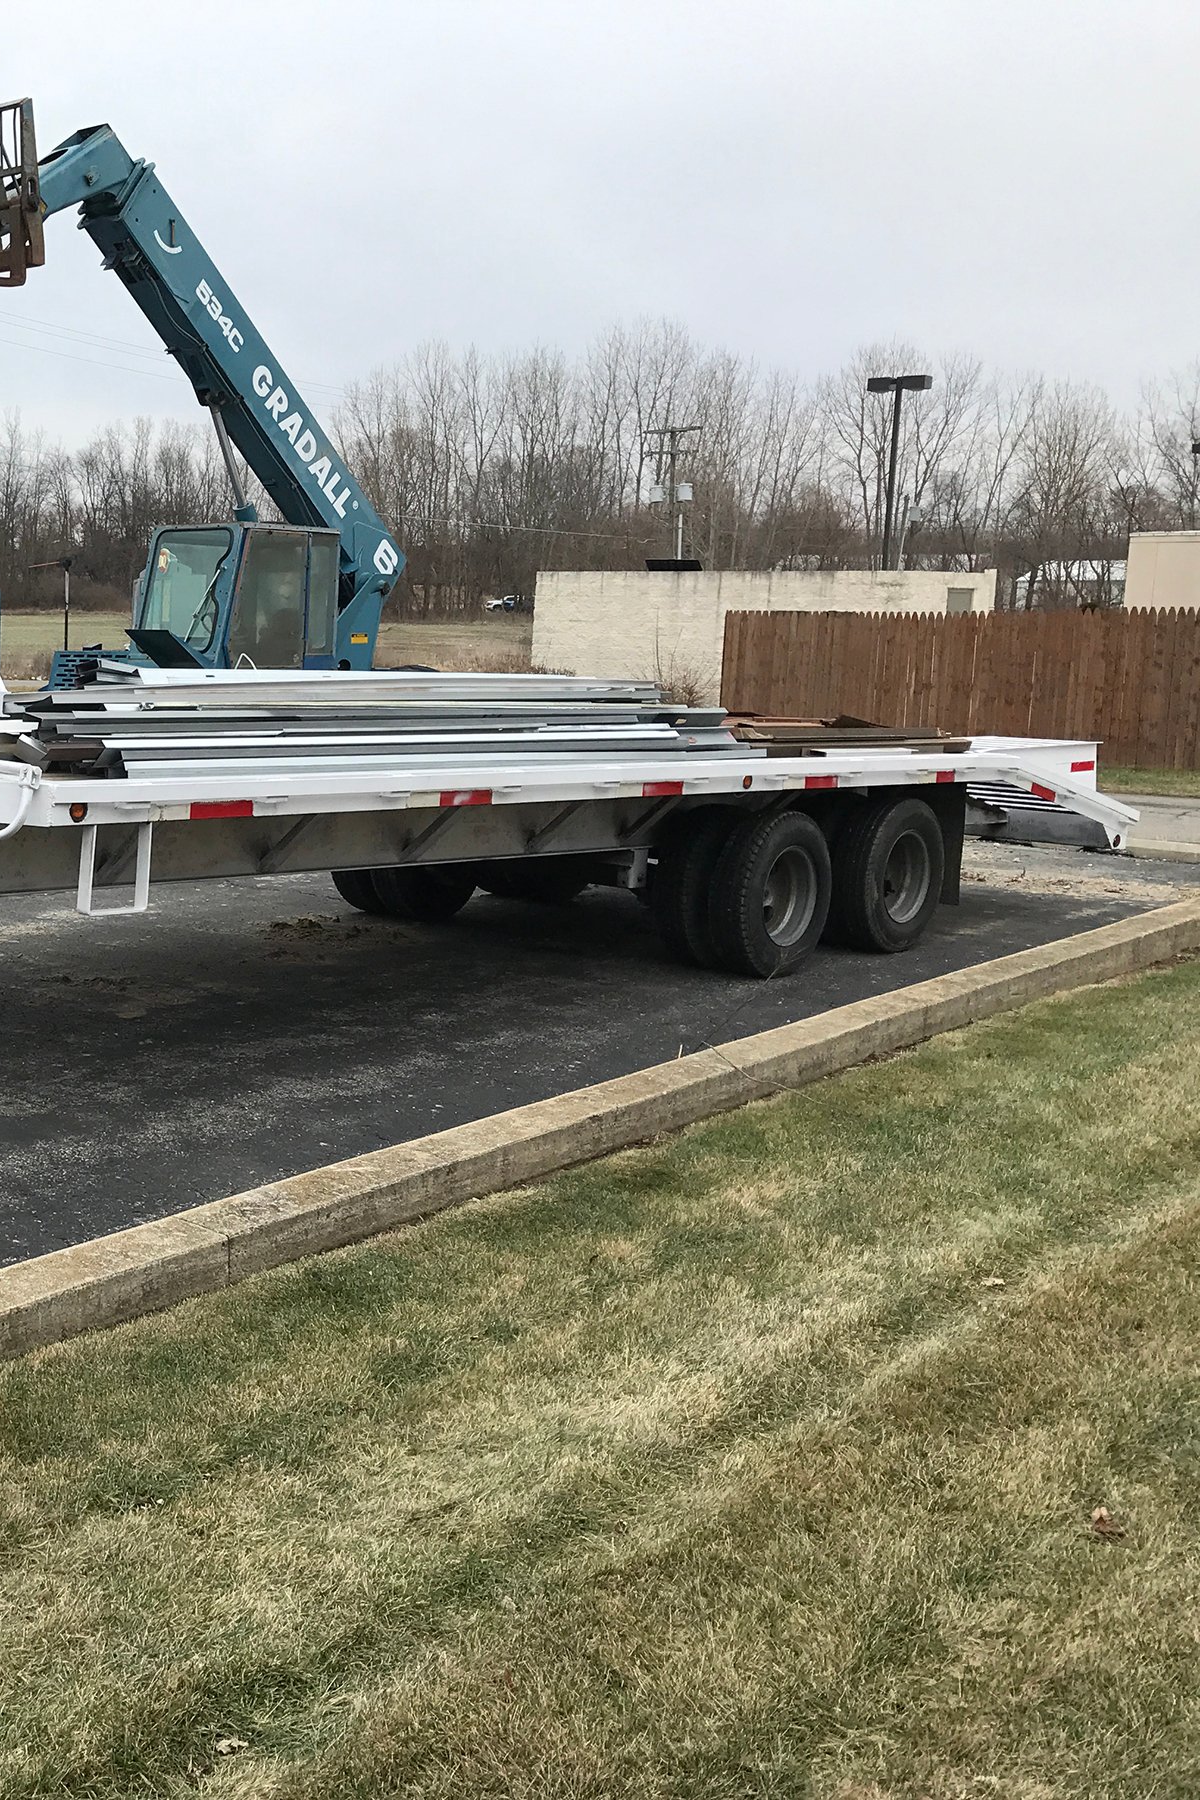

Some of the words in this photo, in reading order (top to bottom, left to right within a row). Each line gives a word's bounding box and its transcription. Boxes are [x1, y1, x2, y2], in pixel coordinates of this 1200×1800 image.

[195, 279, 244, 353] 534C
[253, 365, 351, 518] GRADALL
[373, 539, 398, 575] 6
